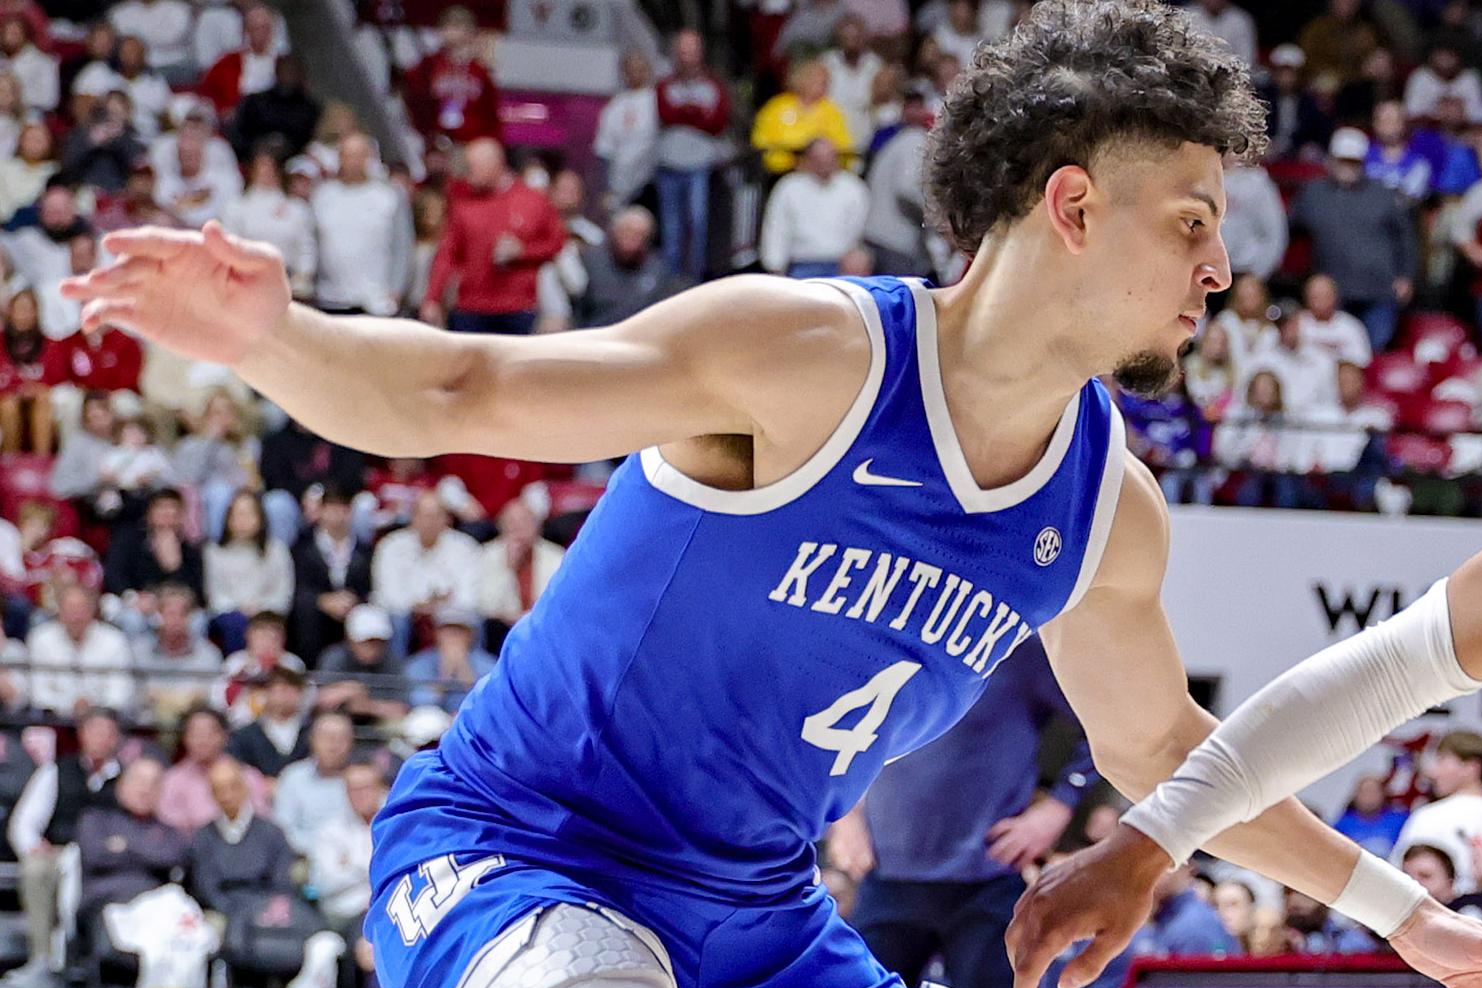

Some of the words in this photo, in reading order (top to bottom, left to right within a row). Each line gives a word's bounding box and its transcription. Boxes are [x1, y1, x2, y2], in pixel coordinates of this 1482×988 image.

[1036, 530, 1060, 562] SEC
[768, 541, 1033, 674] KENTUCKY
[800, 660, 922, 776] 4
